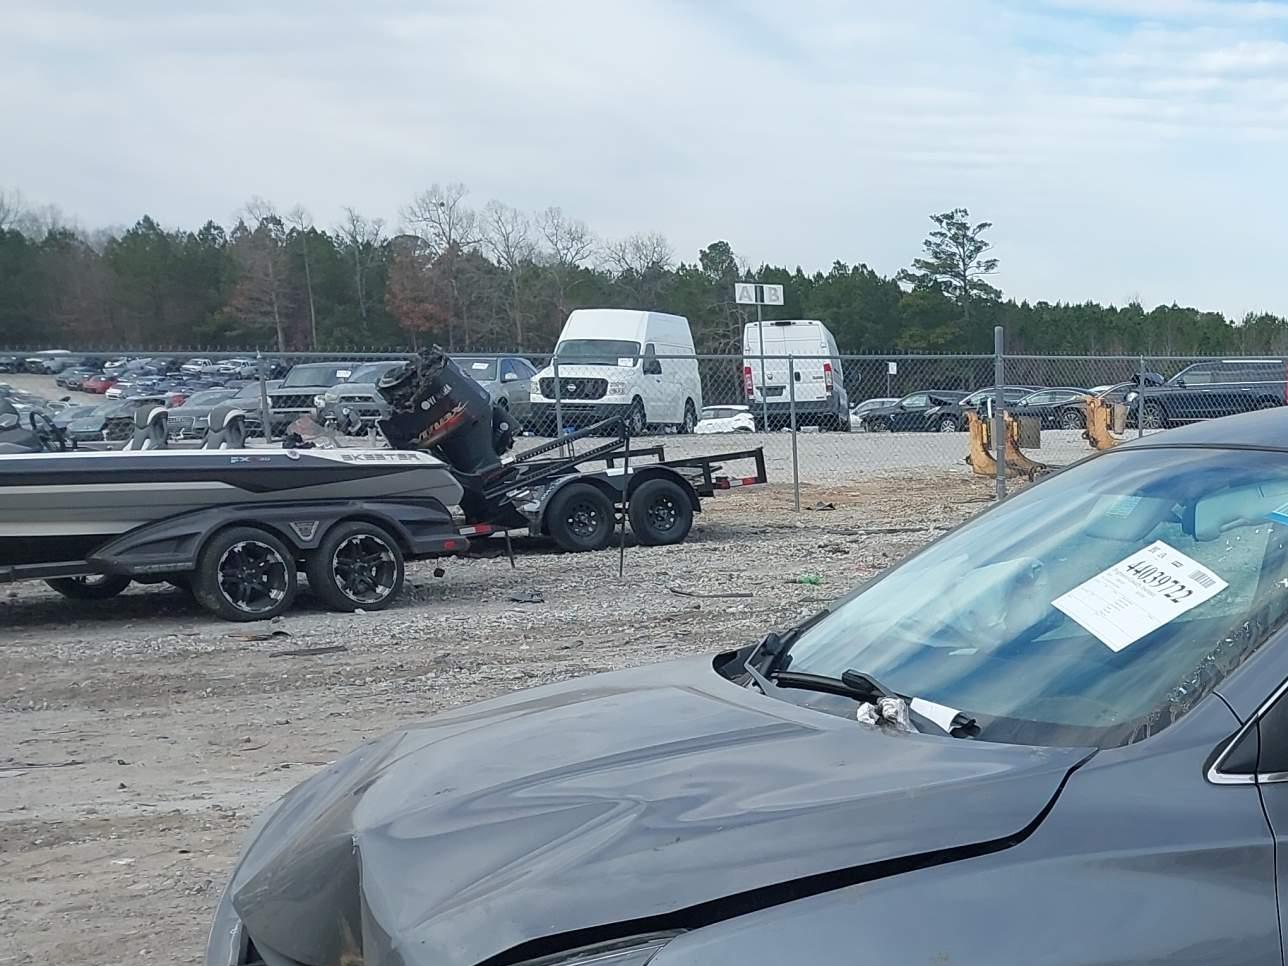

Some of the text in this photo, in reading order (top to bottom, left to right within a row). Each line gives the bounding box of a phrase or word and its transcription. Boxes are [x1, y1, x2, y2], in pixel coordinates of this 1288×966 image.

[739, 286, 780, 302] A B
[341, 453, 420, 462] SKEETER
[1126, 560, 1194, 604] 44039722
